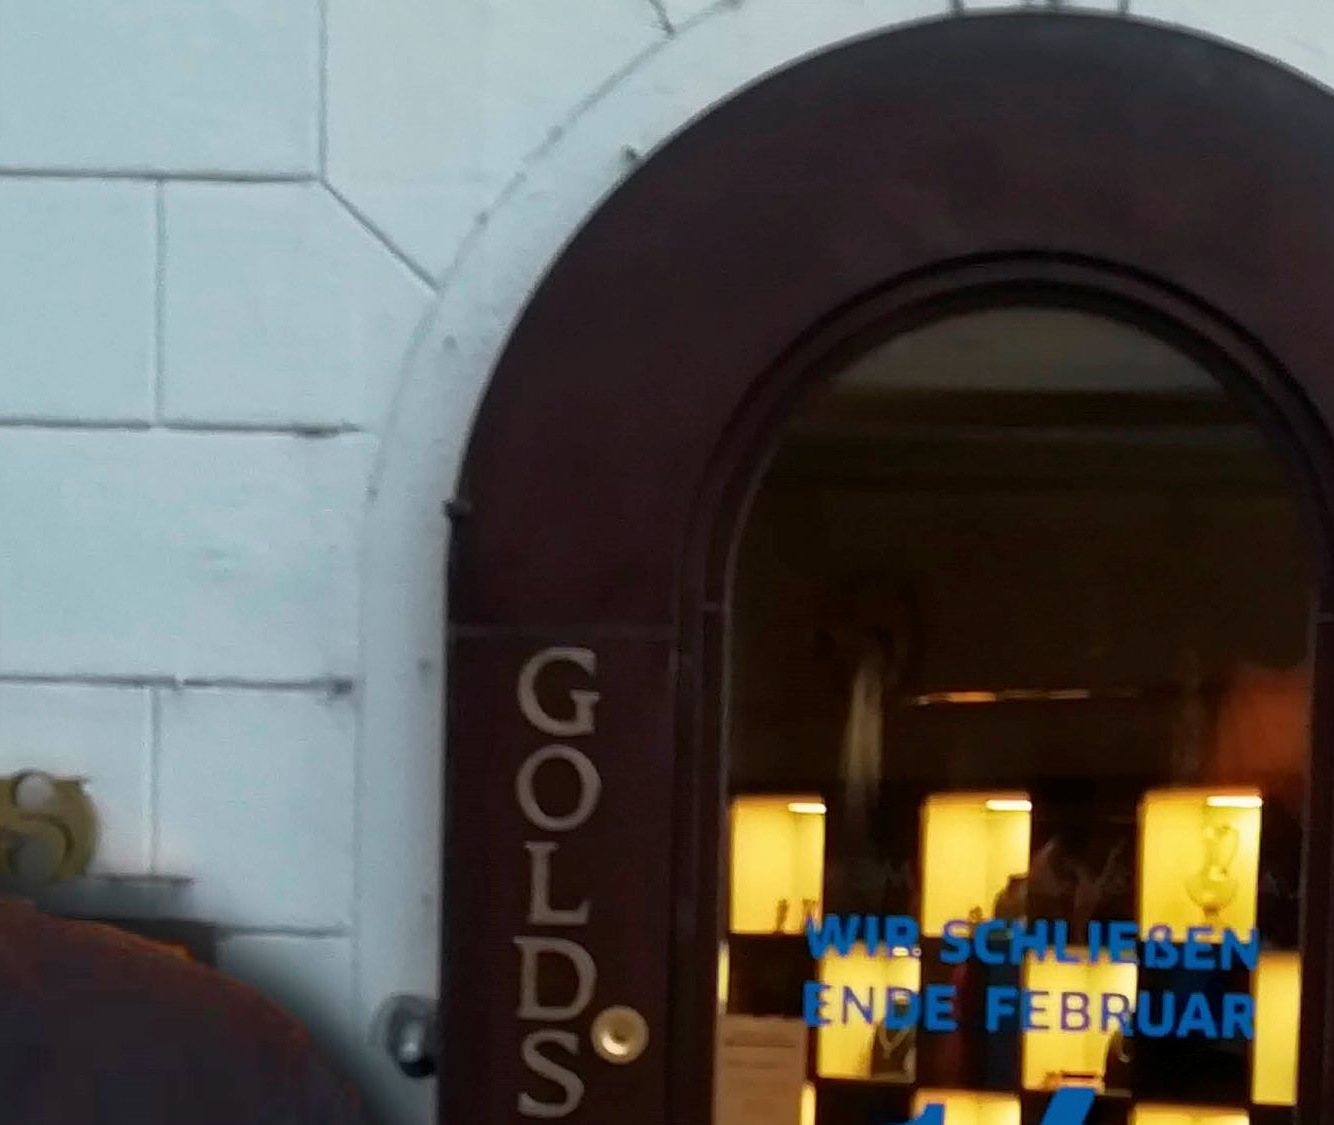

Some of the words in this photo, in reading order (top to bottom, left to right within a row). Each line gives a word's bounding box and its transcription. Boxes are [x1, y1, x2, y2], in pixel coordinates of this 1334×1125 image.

[805, 913, 920, 960] WIR
[804, 984, 958, 1032] ENDE
[986, 988, 1255, 1040] FEBRUAR
